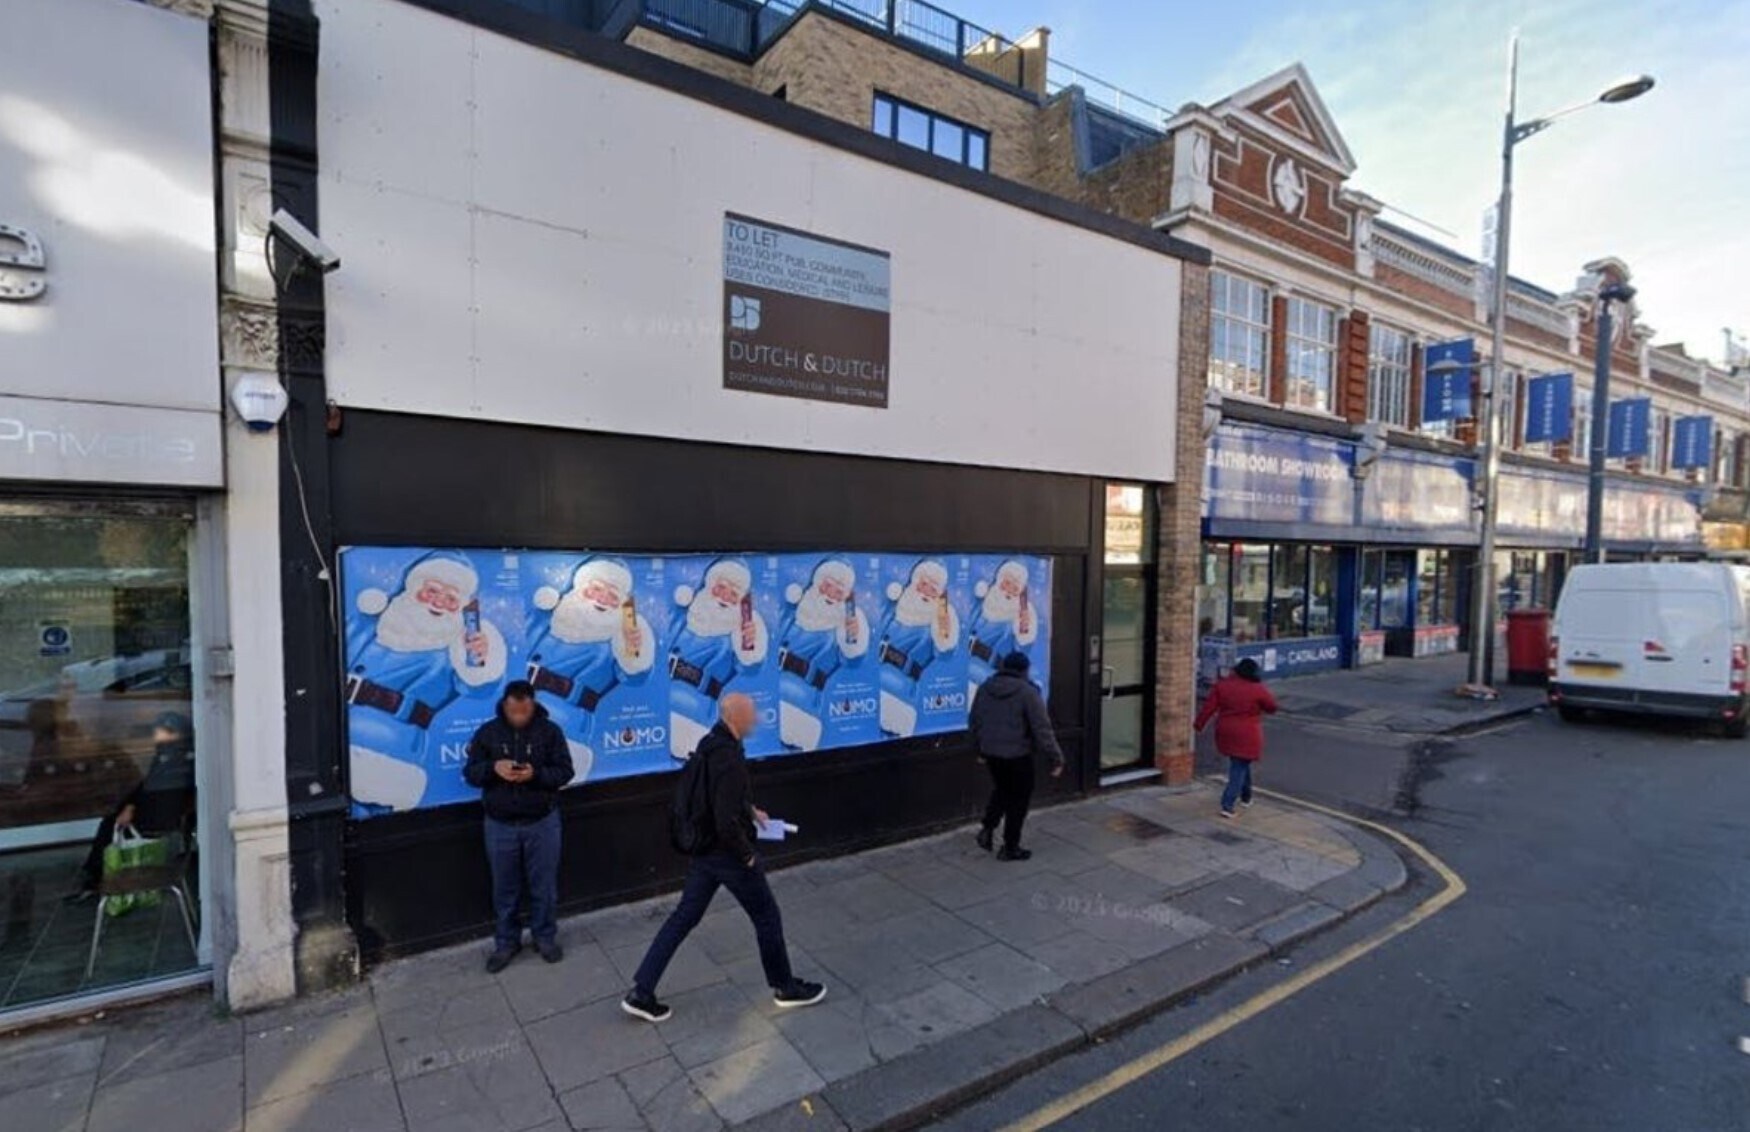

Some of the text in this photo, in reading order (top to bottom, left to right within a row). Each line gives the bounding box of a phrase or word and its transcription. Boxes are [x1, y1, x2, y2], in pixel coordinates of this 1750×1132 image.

[728, 222, 779, 248] TO LET
[729, 340, 885, 382] DUTCH & DUTCH
[0, 418, 196, 464] Private
[829, 697, 877, 717] NOMO
[923, 692, 966, 711] NOMO
[603, 725, 667, 749] NOMO
